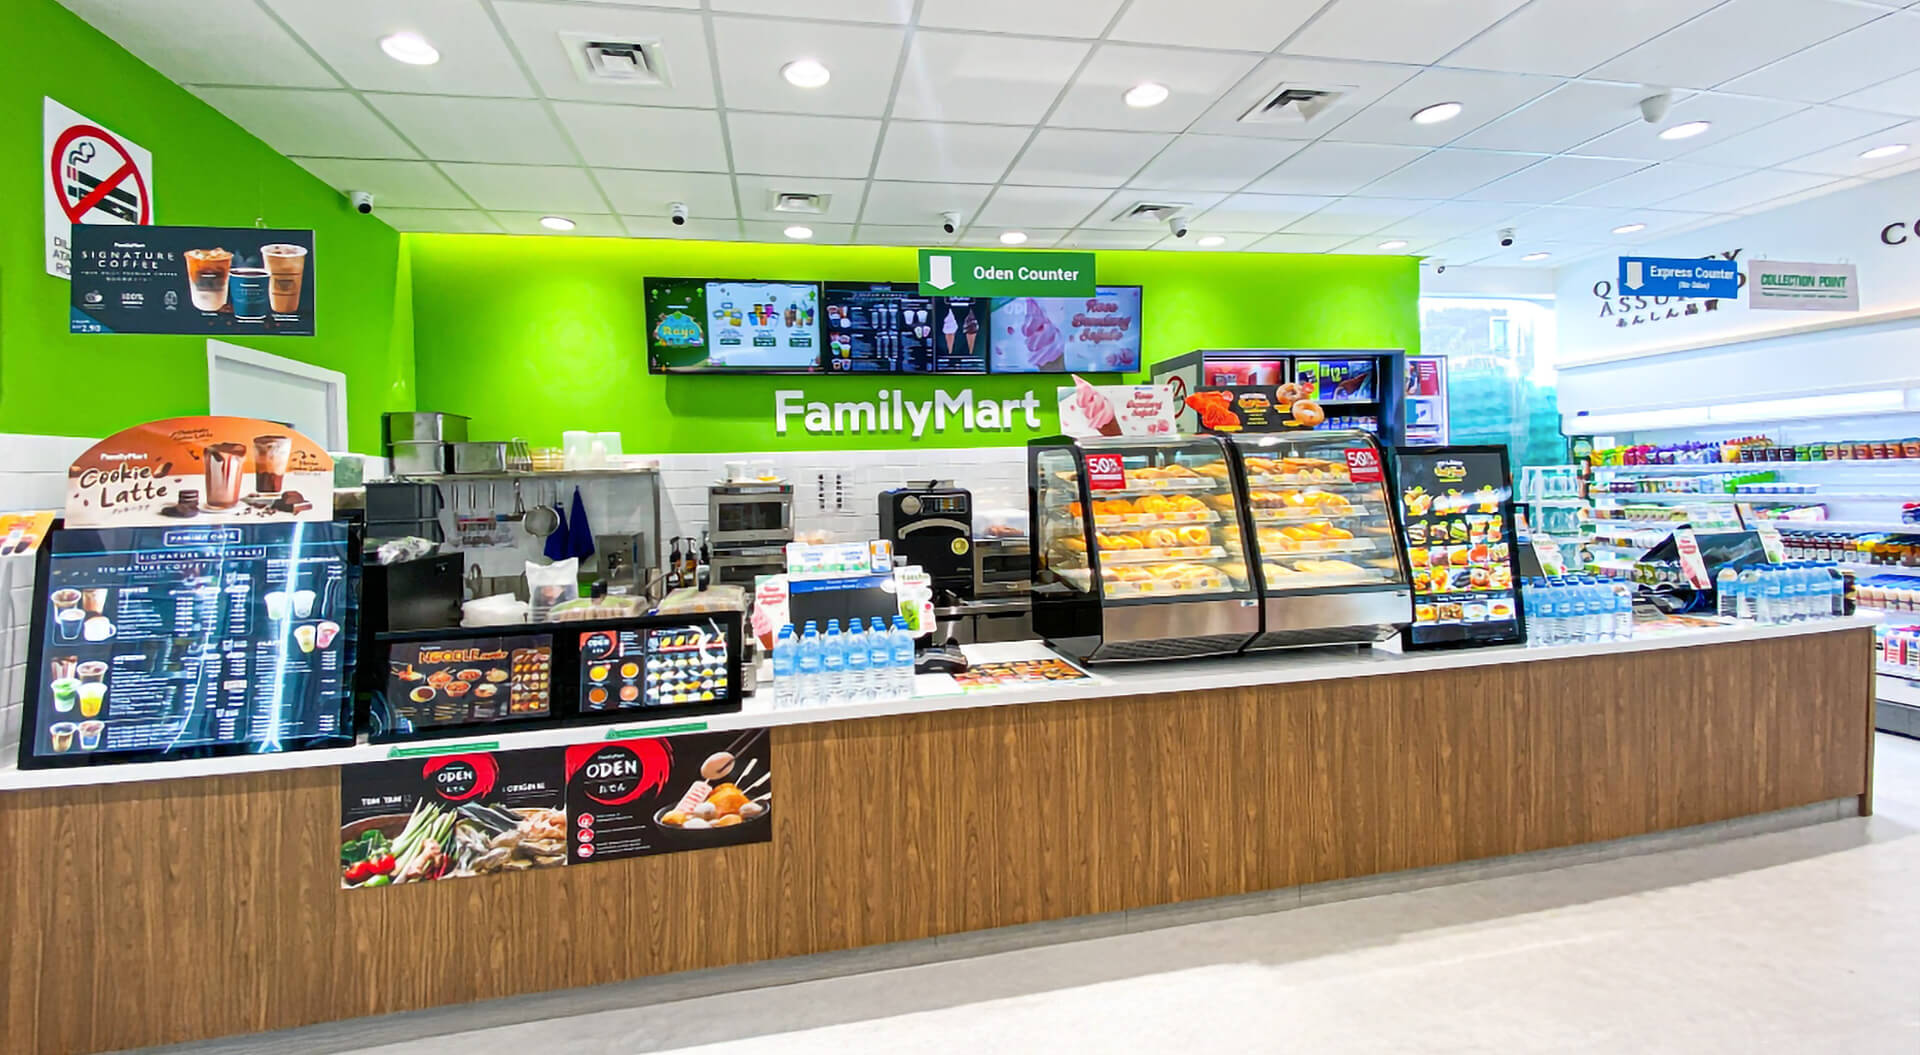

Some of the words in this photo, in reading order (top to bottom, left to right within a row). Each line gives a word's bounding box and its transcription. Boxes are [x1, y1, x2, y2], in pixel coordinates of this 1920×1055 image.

[82, 251, 175, 261] SIGNATURE
[98, 259, 159, 269] COFFEE
[973, 265, 1013, 280] Oden
[1017, 266, 1079, 281] Counter
[1650, 265, 1693, 280] Express
[1695, 267, 1734, 280] Counter
[1760, 273, 1815, 287] COLLECTION
[1819, 276, 1847, 288] POINT
[775, 389, 1041, 438] FamilyMart
[80, 463, 150, 489] Cookie
[100, 481, 168, 508] Latte
[586, 760, 637, 778] ODEN
[438, 771, 472, 783] ODEN
